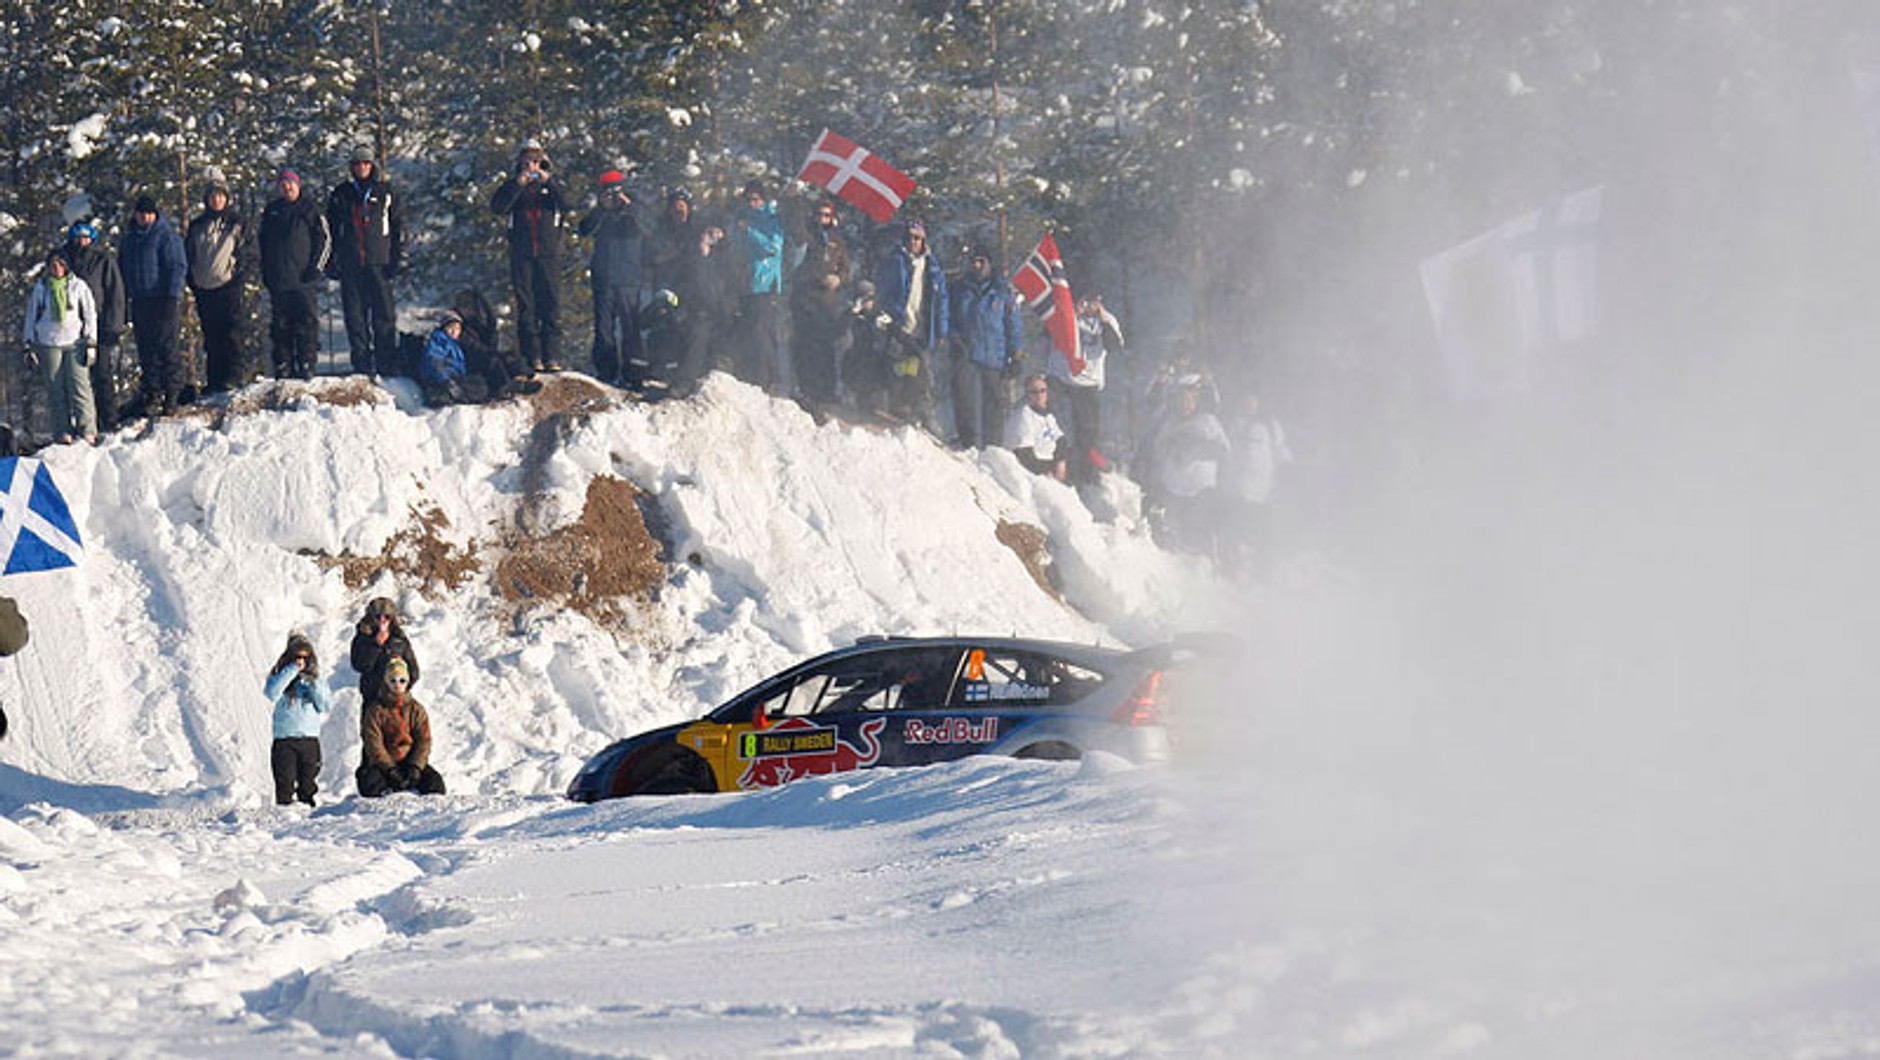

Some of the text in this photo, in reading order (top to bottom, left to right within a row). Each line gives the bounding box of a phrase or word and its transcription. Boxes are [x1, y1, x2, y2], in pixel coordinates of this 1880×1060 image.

[904, 717, 998, 744] Red Bull
[745, 734, 756, 757] 8
[763, 736, 790, 752] RALLY
[794, 732, 833, 751] SWEDEN
